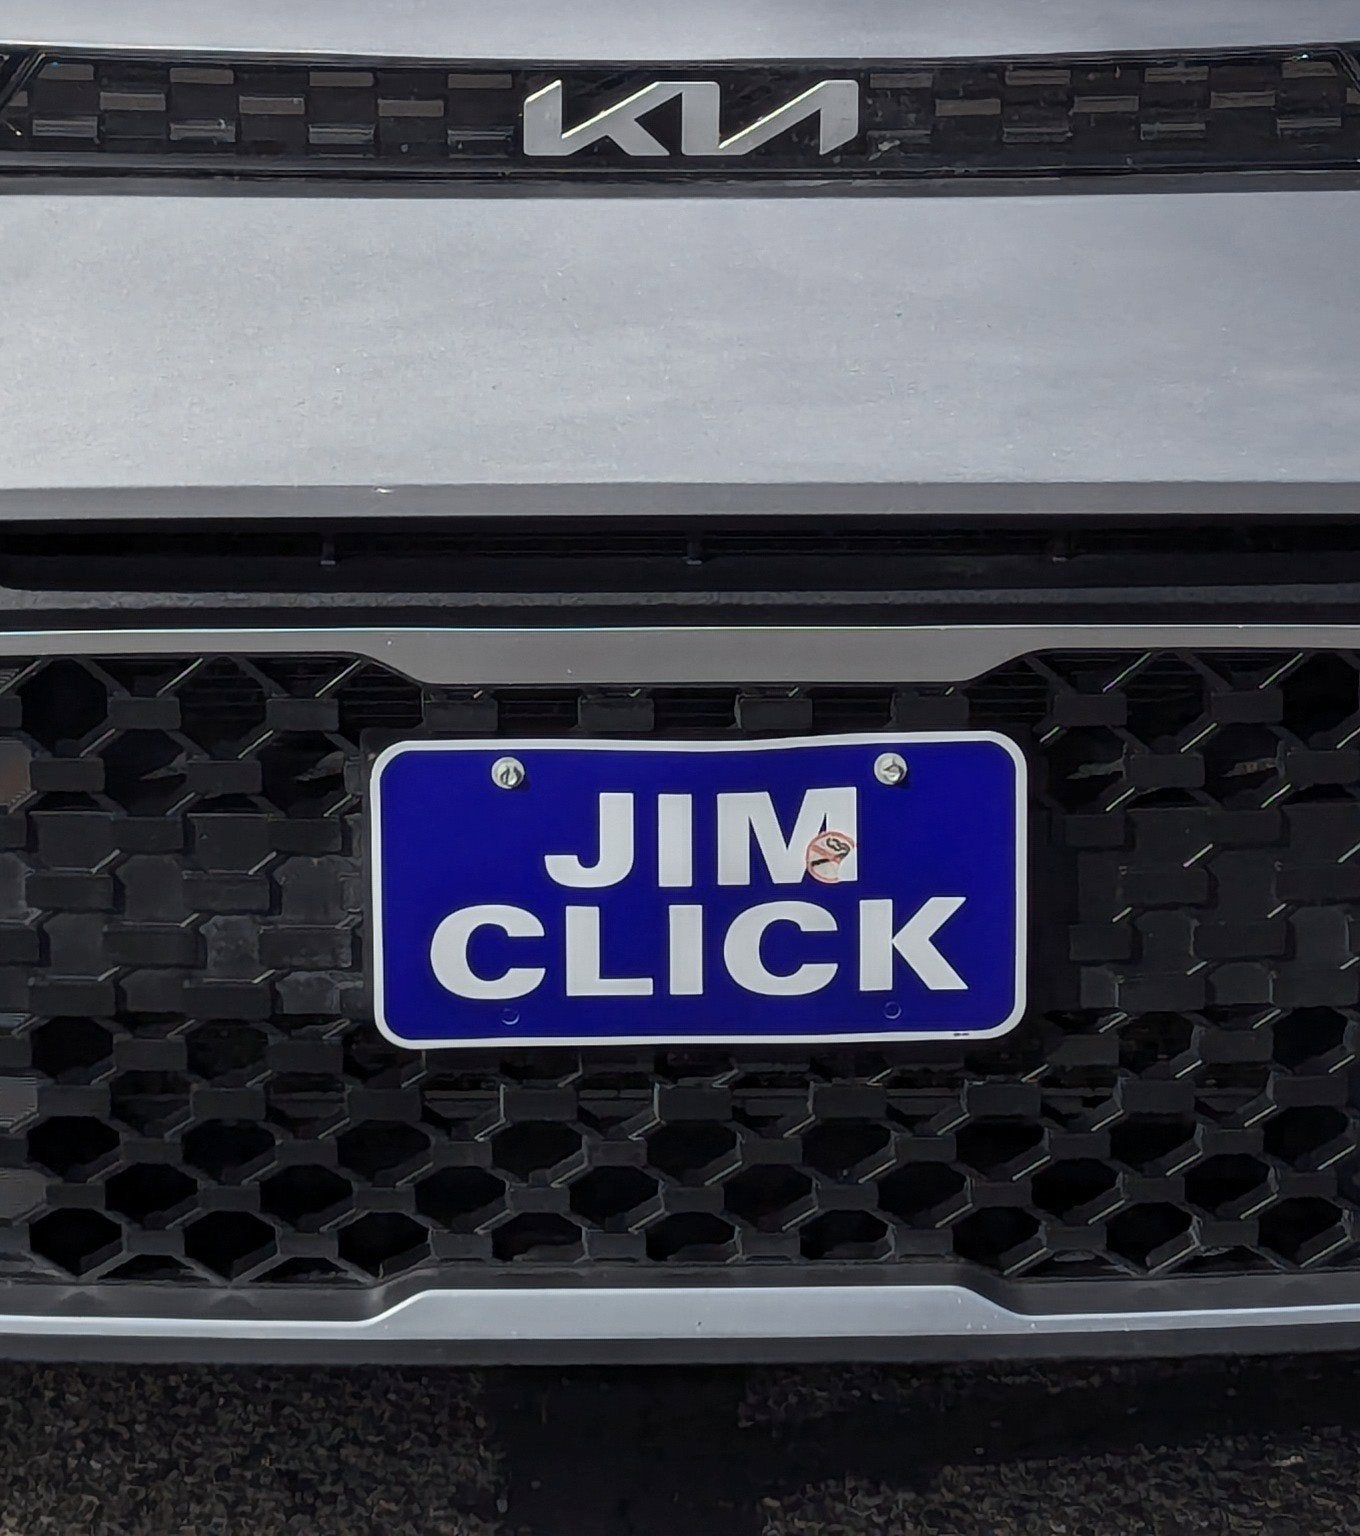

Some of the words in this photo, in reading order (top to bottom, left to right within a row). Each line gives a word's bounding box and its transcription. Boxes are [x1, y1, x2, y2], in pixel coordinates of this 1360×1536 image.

[523, 79, 859, 156] KIA
[544, 786, 858, 888] JIM
[430, 896, 969, 1000] CLICK
